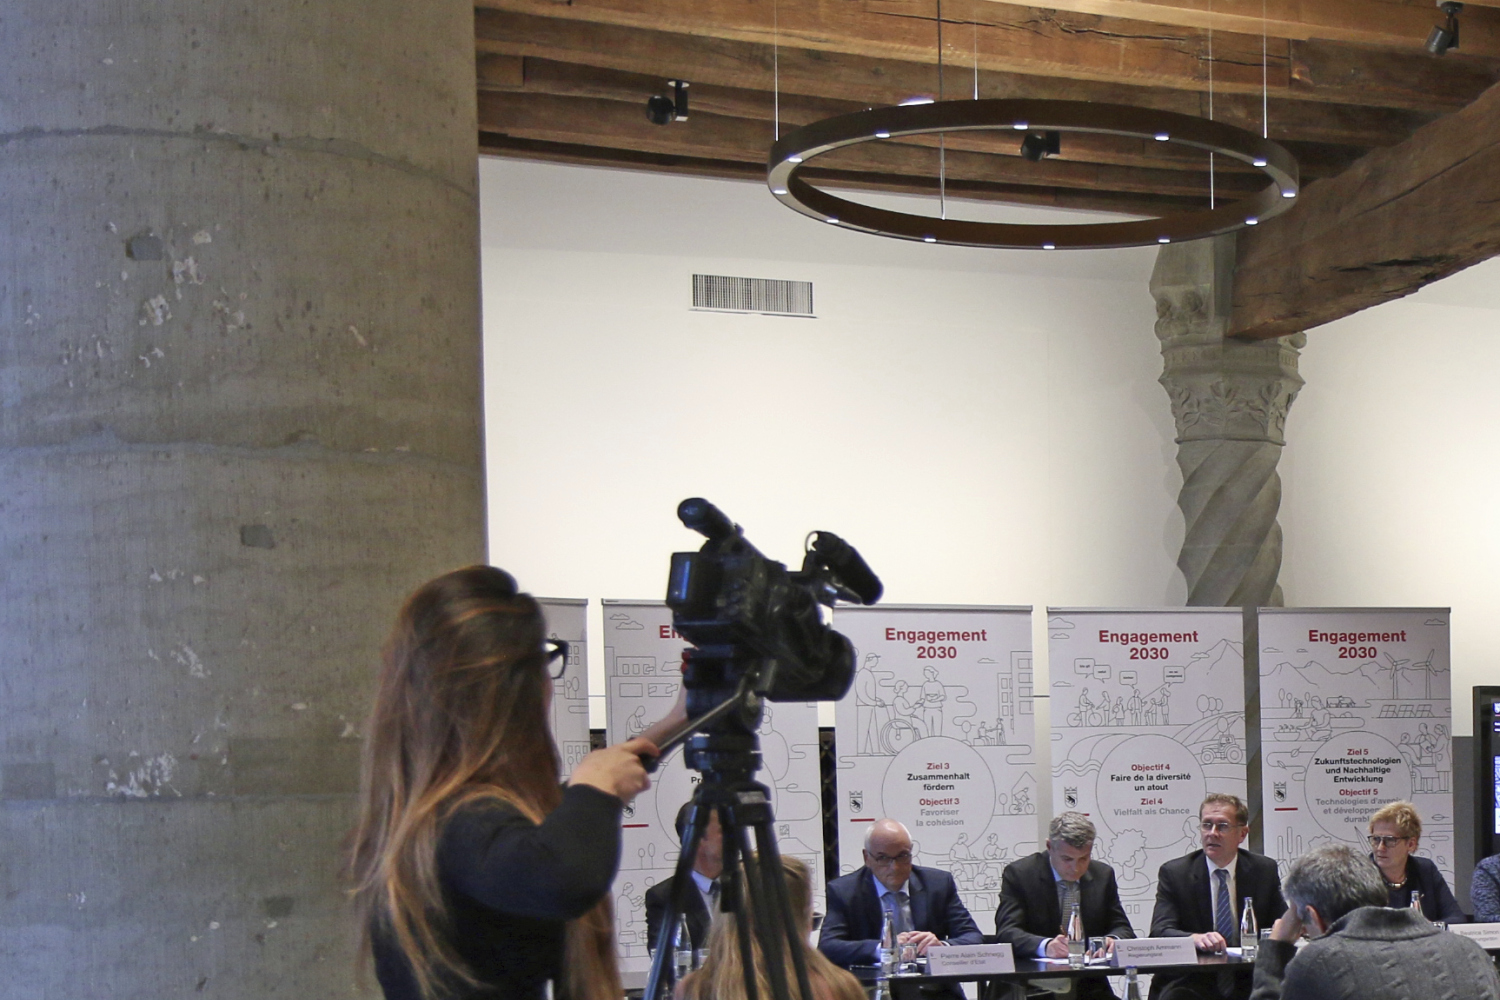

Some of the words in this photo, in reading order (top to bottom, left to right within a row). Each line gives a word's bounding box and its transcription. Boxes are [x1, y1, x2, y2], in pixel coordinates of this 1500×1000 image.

[885, 627, 987, 644] Engagement
[1099, 630, 1199, 645] Engagement
[1308, 629, 1407, 645] Engagement
[916, 646, 957, 659] 2030
[1129, 647, 1170, 660] 2030
[1338, 646, 1378, 659] 2030
[1347, 748, 1362, 756] Ziel
[1363, 748, 1369, 756] 5
[926, 762, 943, 770] Ziel
[944, 762, 950, 770] 3
[1314, 757, 1402, 766] Zukunftstechnologien
[1131, 763, 1164, 772] Objectif
[1164, 763, 1171, 771] 4
[1343, 766, 1391, 775] Nachhaltige
[907, 772, 970, 781] Zusammenhalt
[1110, 774, 1132, 782] Faire
[1133, 774, 1144, 782] de
[1146, 773, 1154, 781] la
[1156, 772, 1191, 781] diversité
[1333, 775, 1384, 783] Entwicklung
[923, 783, 955, 791] fördern
[1147, 783, 1169, 791] atout
[1339, 789, 1371, 797] Objectif
[919, 798, 953, 807] Objectif
[1140, 798, 1156, 806] Ziel
[1315, 798, 1369, 806] Technologies
[920, 808, 960, 816] Favoriser
[1113, 808, 1143, 816] Vielfalt
[1144, 807, 1157, 816] als
[1159, 807, 1190, 815] Chance
[916, 819, 924, 827] la
[925, 818, 964, 827] cohésion
[1344, 815, 1370, 823] durabl
